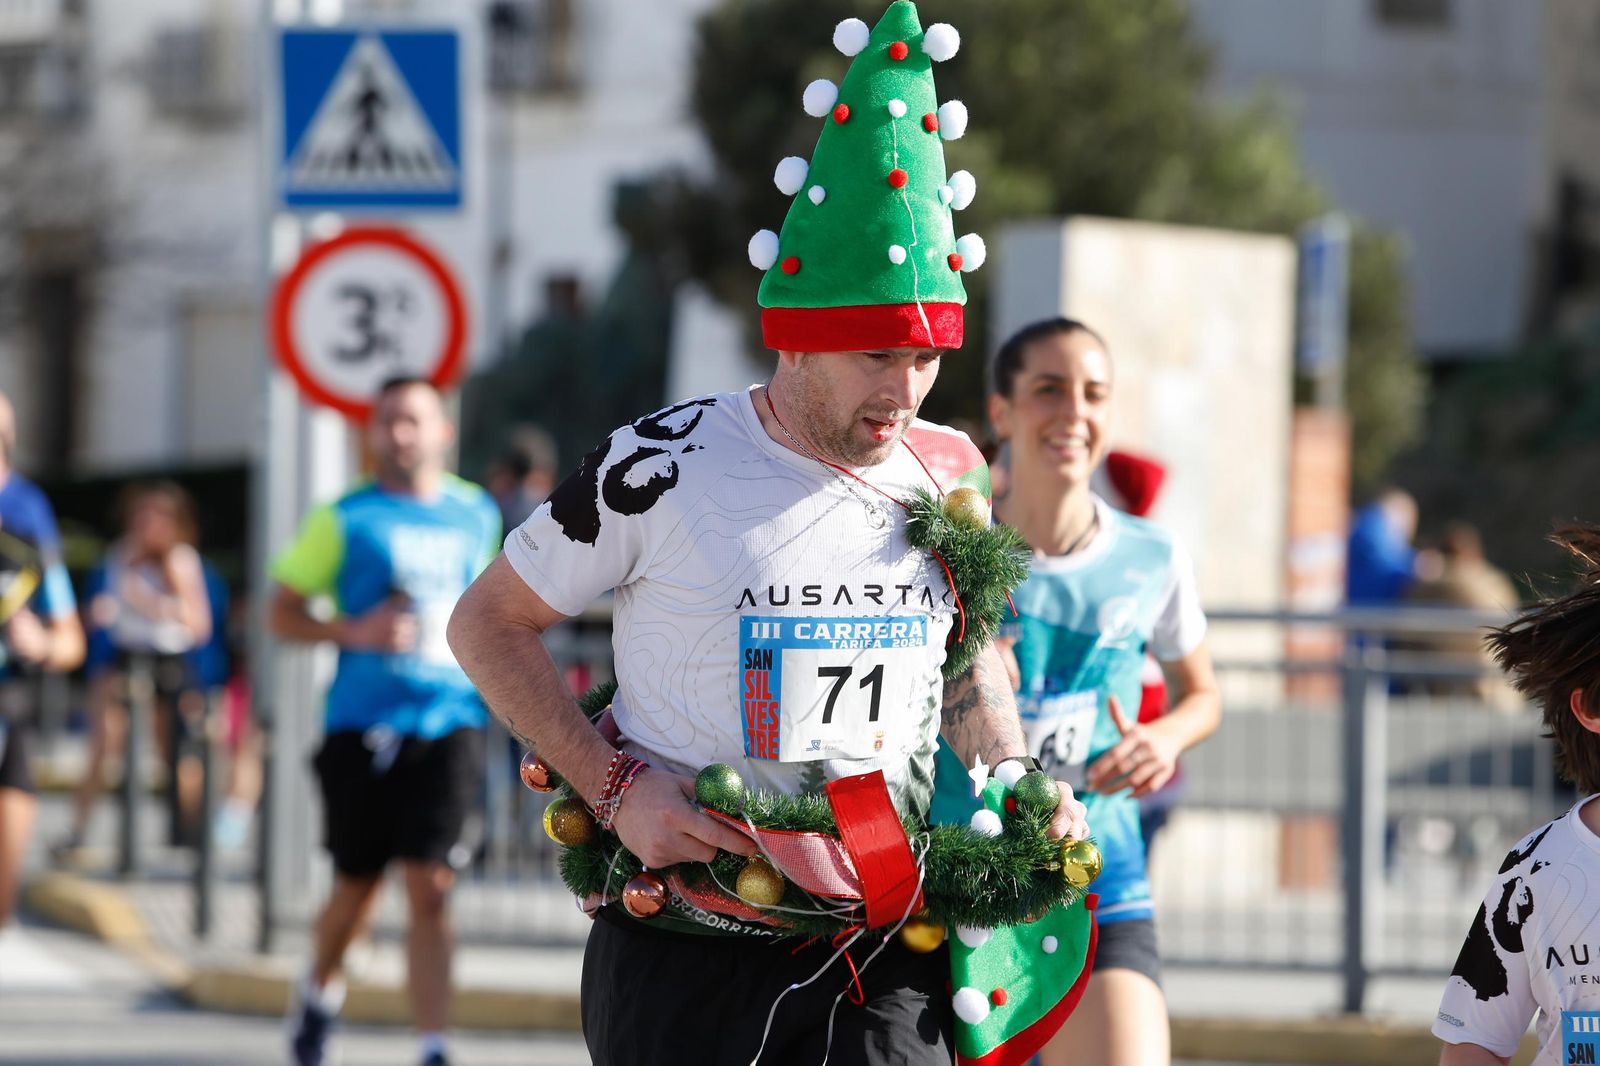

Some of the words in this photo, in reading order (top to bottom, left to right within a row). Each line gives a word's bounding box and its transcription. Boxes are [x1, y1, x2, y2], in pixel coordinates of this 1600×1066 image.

[750, 622, 783, 639] III
[794, 621, 924, 640] CARRERA
[829, 639, 883, 650] TARIFA
[892, 638, 924, 649] 2024
[744, 648, 773, 670] SAN
[744, 670, 772, 700] SIL
[817, 664, 885, 724] 71
[744, 701, 780, 731] VES
[747, 729, 780, 760] TRE
[1567, 1042, 1596, 1065] SAN
